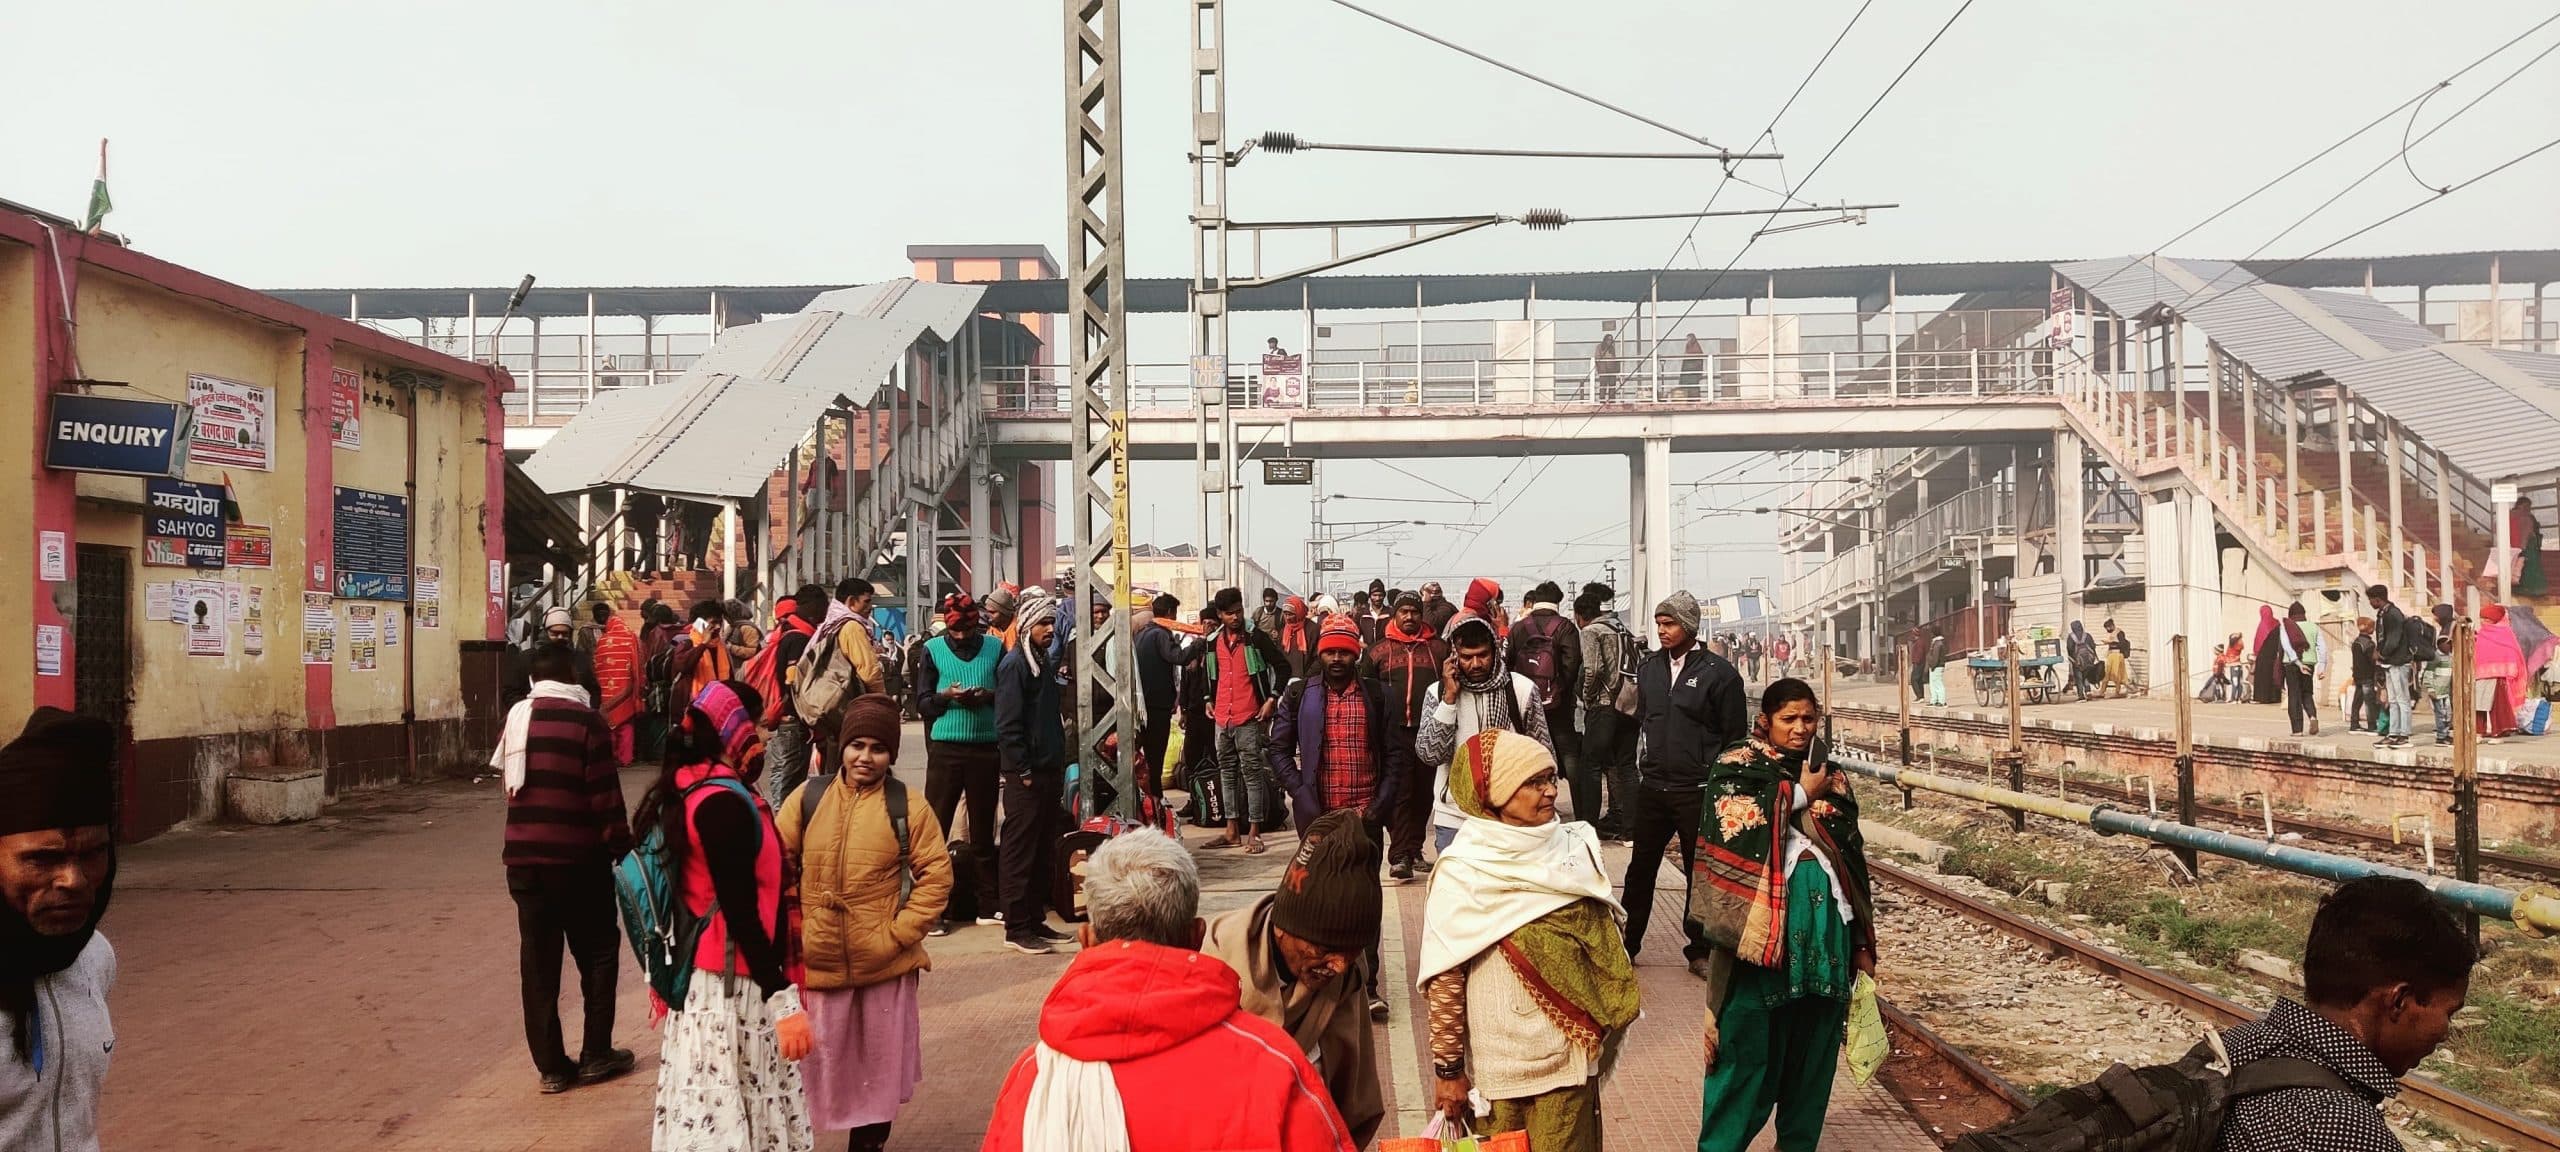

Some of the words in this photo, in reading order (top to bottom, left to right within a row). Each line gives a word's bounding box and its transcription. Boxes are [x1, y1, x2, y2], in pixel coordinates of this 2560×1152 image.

[1193, 356, 1223, 370] NKE
[58, 420, 167, 447] ENQUIRY
[152, 489, 220, 518] सहयोग
[157, 519, 216, 538] SAHYOG
